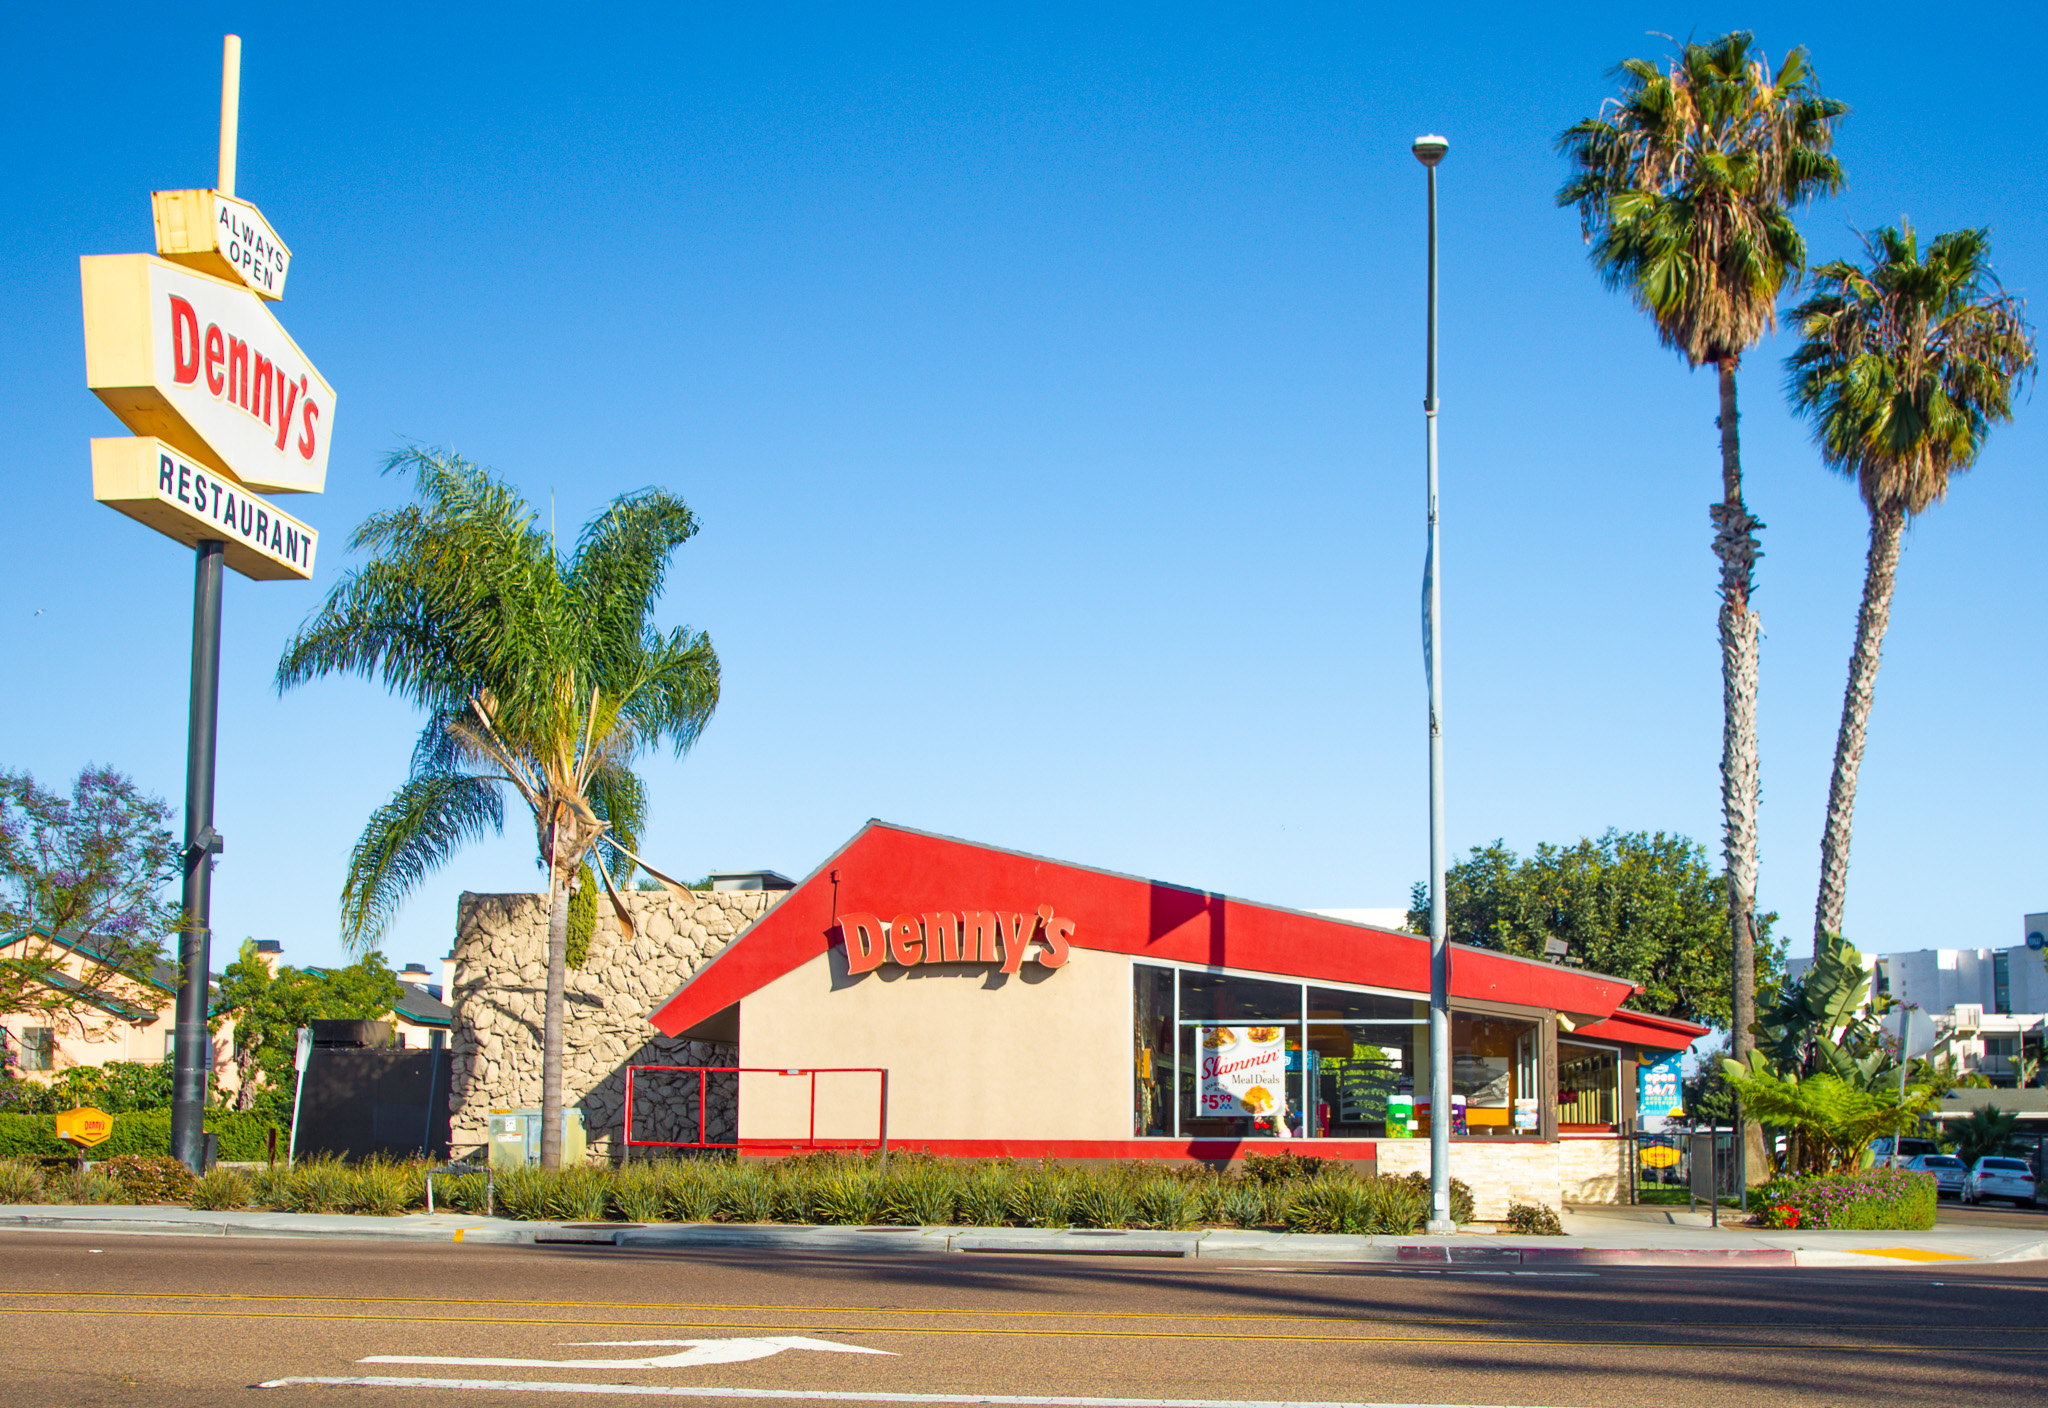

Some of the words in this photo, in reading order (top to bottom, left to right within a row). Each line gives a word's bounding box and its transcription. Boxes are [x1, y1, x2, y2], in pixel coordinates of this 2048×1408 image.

[219, 206, 284, 273] ALWAYS
[229, 240, 273, 290] OPEN
[169, 294, 319, 461] Denny's
[159, 453, 311, 569] RESTAURANT
[837, 903, 1076, 975] Denny's
[1201, 1049, 1280, 1080] Slammin'
[1232, 1075, 1254, 1084] Meal
[1255, 1074, 1280, 1084] Deals
[1644, 1073, 1677, 1085] open
[1644, 1083, 1677, 1096] 24/7
[85, 1121, 104, 1131] Denny's
